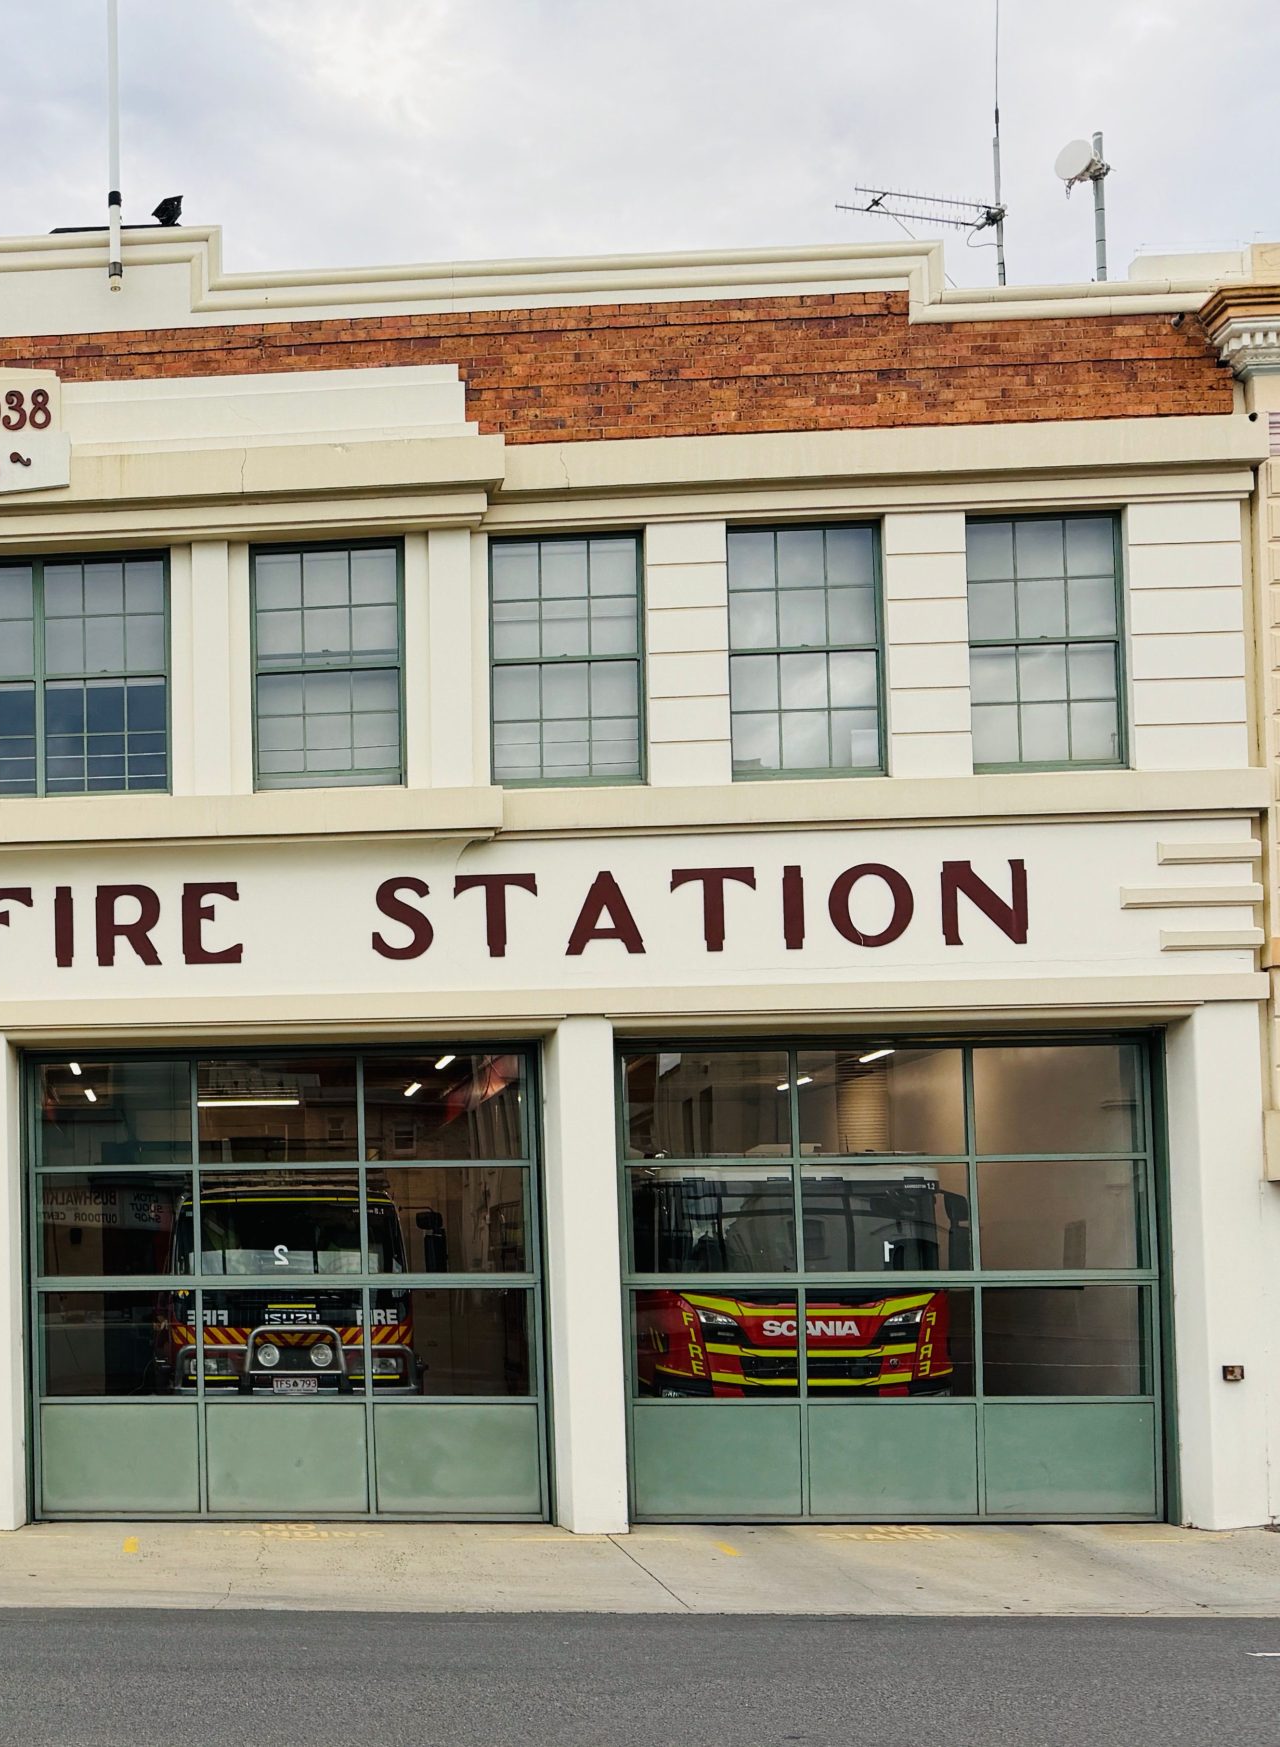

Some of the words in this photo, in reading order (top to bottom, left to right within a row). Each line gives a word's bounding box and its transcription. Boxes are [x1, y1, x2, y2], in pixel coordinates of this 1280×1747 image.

[371, 858, 1030, 961] STATION
[762, 1320, 860, 1337] SCANIA
[682, 1311, 706, 1376] FIRE
[274, 1379, 292, 1388] TFS
[299, 1379, 317, 1388] 793
[195, 1529, 386, 1538] TANDING
[261, 1523, 317, 1531] NO
